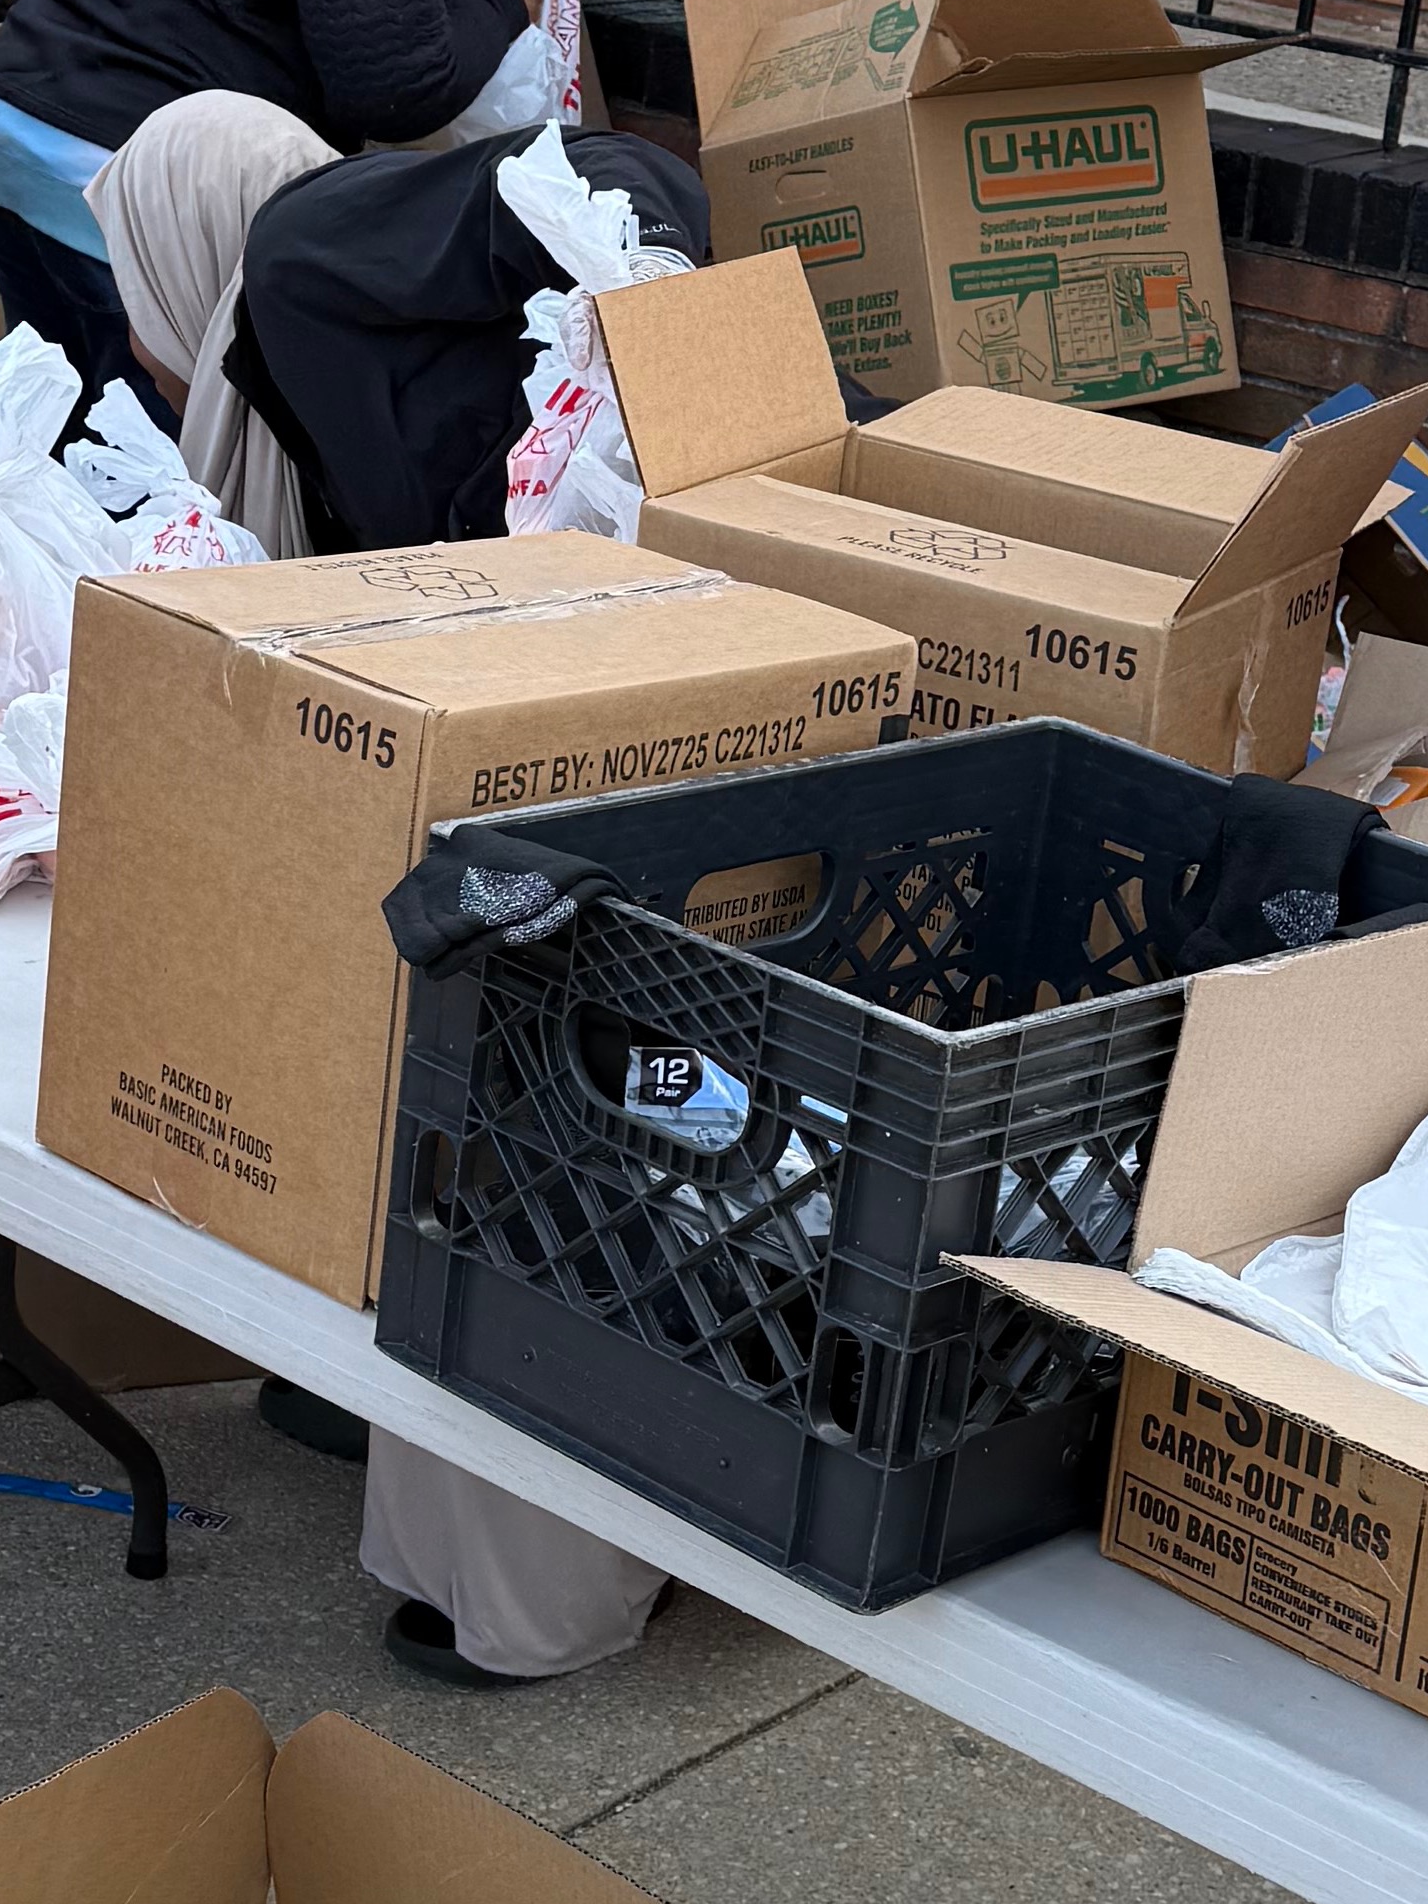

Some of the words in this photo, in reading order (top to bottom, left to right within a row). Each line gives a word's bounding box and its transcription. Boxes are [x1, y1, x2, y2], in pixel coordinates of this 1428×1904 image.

[809, 137, 854, 160] HANDLES
[979, 120, 1150, 175] U-HAUL
[824, 299, 853, 318] NEED
[1286, 579, 1332, 630] 10615
[917, 637, 1021, 692] C221311
[1025, 623, 1139, 681] 10615
[810, 670, 902, 720] 10615
[294, 696, 398, 770] 10615
[472, 757, 545, 808] BEST
[549, 746, 594, 796] BY:
[600, 732, 710, 786] NOV2725
[714, 714, 806, 766] C221312
[751, 893, 770, 914] BY
[772, 884, 806, 908] USDA
[748, 915, 788, 939] STATE
[161, 1063, 212, 1105] PACKED
[215, 1089, 233, 1115] BY
[648, 1057, 690, 1085] 12
[655, 1086, 682, 1098] Pair
[119, 1070, 156, 1106] BASIC
[159, 1092, 227, 1142] AMERICAN
[229, 1125, 273, 1164] FOODS
[111, 1094, 162, 1138] WALNUT
[164, 1123, 209, 1165] CREEK,
[213, 1147, 230, 1174] CA
[234, 1159, 278, 1195] 94597
[1140, 1413, 1305, 1519] CARRY-OUT
[1310, 1492, 1392, 1561] BAGS
[1127, 1485, 1181, 1533] 1000
[1185, 1514, 1247, 1566] BAGS
[1183, 1472, 1232, 1509] BOLSAS
[1236, 1498, 1265, 1525] TIPO
[1269, 1511, 1336, 1559] CAMISETA
[1147, 1532, 1169, 1555] 1/6
[1172, 1542, 1217, 1580] Barrel
[1255, 1546, 1299, 1577] Grocery
[1253, 1560, 1332, 1609] CONVENIENCE
[1249, 1591, 1313, 1632] CARRY-OUT
[1250, 1576, 1323, 1620] RESTAURANT
[1324, 1610, 1353, 1636] TAKE
[1356, 1630, 1380, 1648] OUT
